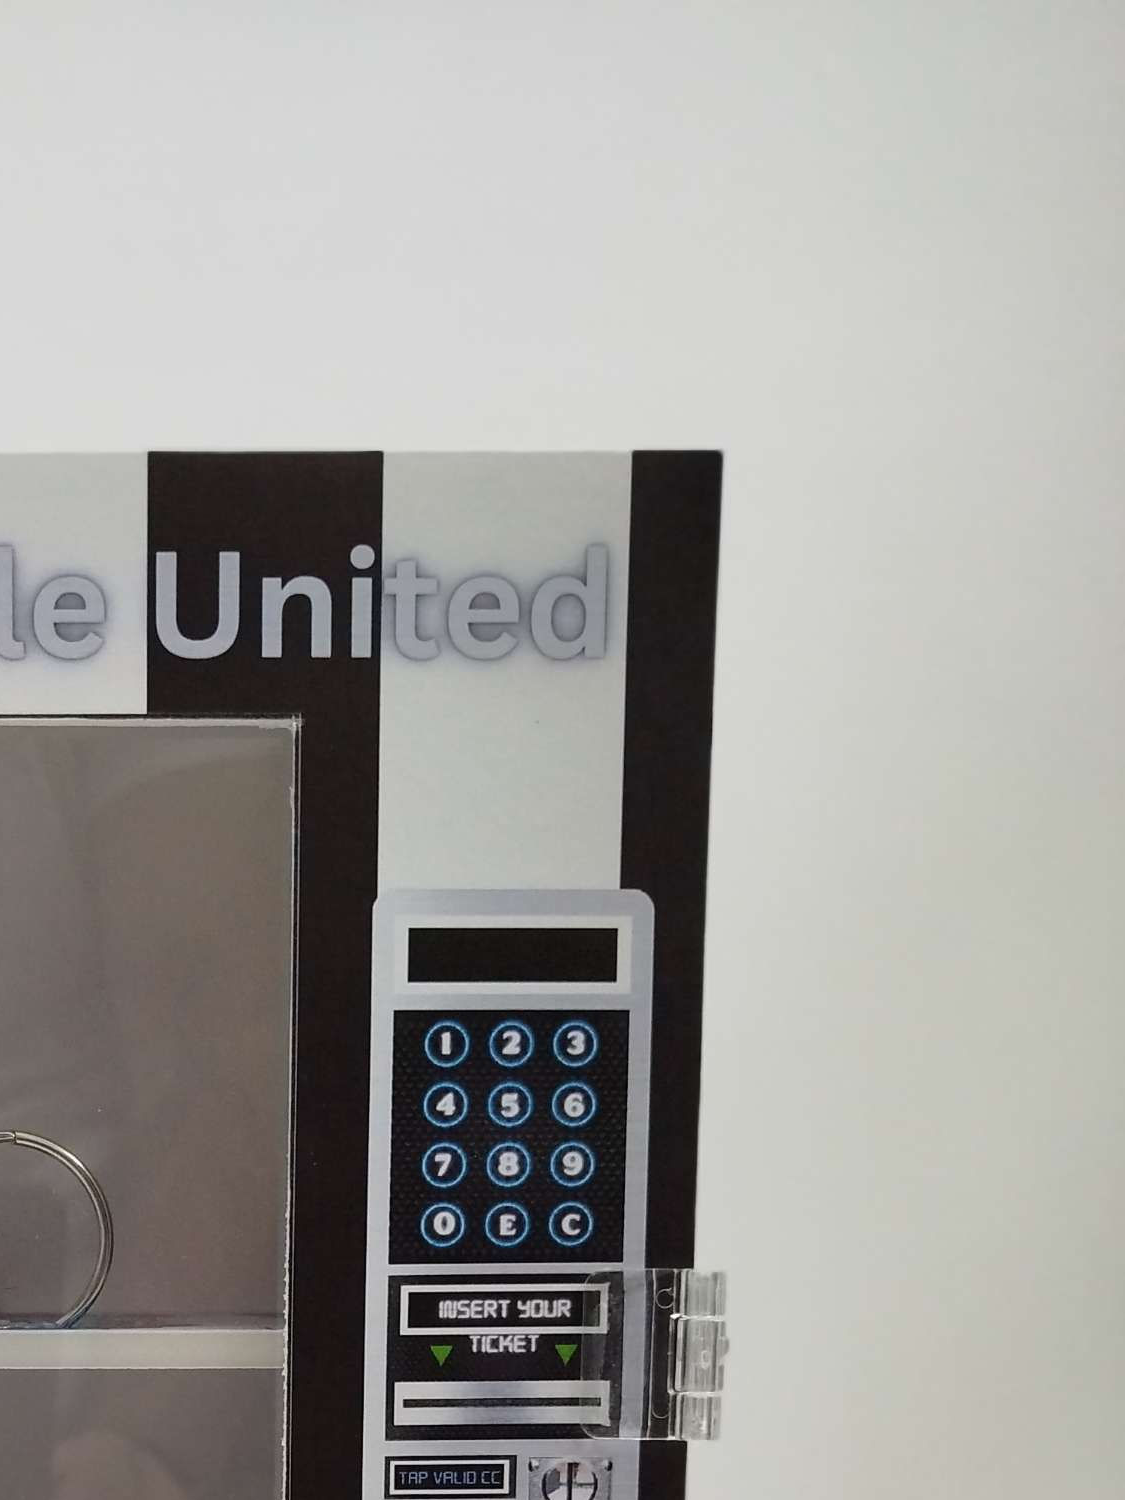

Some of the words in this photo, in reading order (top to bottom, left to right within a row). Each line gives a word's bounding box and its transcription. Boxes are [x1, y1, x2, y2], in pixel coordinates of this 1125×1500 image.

[154, 543, 609, 663] United
[440, 1031, 452, 1055] 1
[501, 1031, 522, 1055] 2
[566, 1030, 586, 1055] 3
[435, 1092, 456, 1116] 4
[500, 1093, 520, 1118] 5
[563, 1092, 585, 1118] 6
[434, 1152, 452, 1177] 7
[497, 1151, 520, 1176] 8
[561, 1151, 584, 1176] 9
[498, 1213, 517, 1236] E
[438, 1299, 511, 1319] INSERT
[516, 1299, 572, 1319] YOUR
[468, 1334, 540, 1354] TICKET
[398, 1471, 428, 1485] TAP
[432, 1471, 476, 1485] VALID
